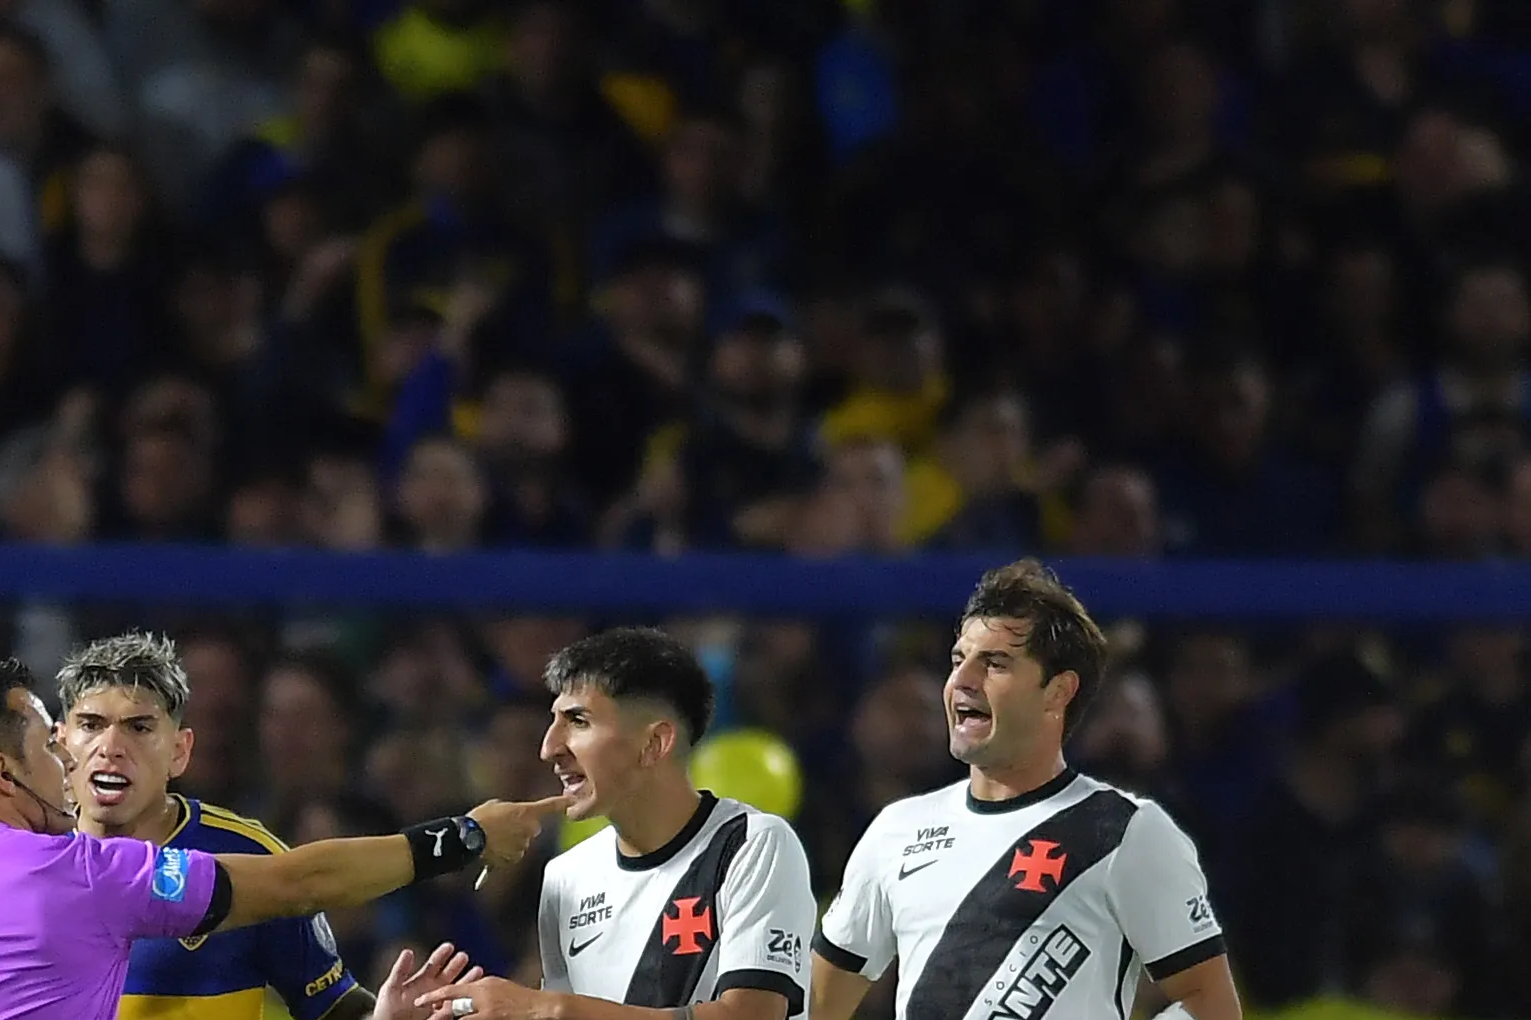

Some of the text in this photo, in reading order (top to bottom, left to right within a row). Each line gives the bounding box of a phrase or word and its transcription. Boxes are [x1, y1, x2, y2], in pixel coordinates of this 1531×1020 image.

[917, 826, 949, 842] VIVA
[902, 838, 955, 856] SORTE
[580, 892, 605, 912] VIVA
[569, 905, 613, 929] SORTE
